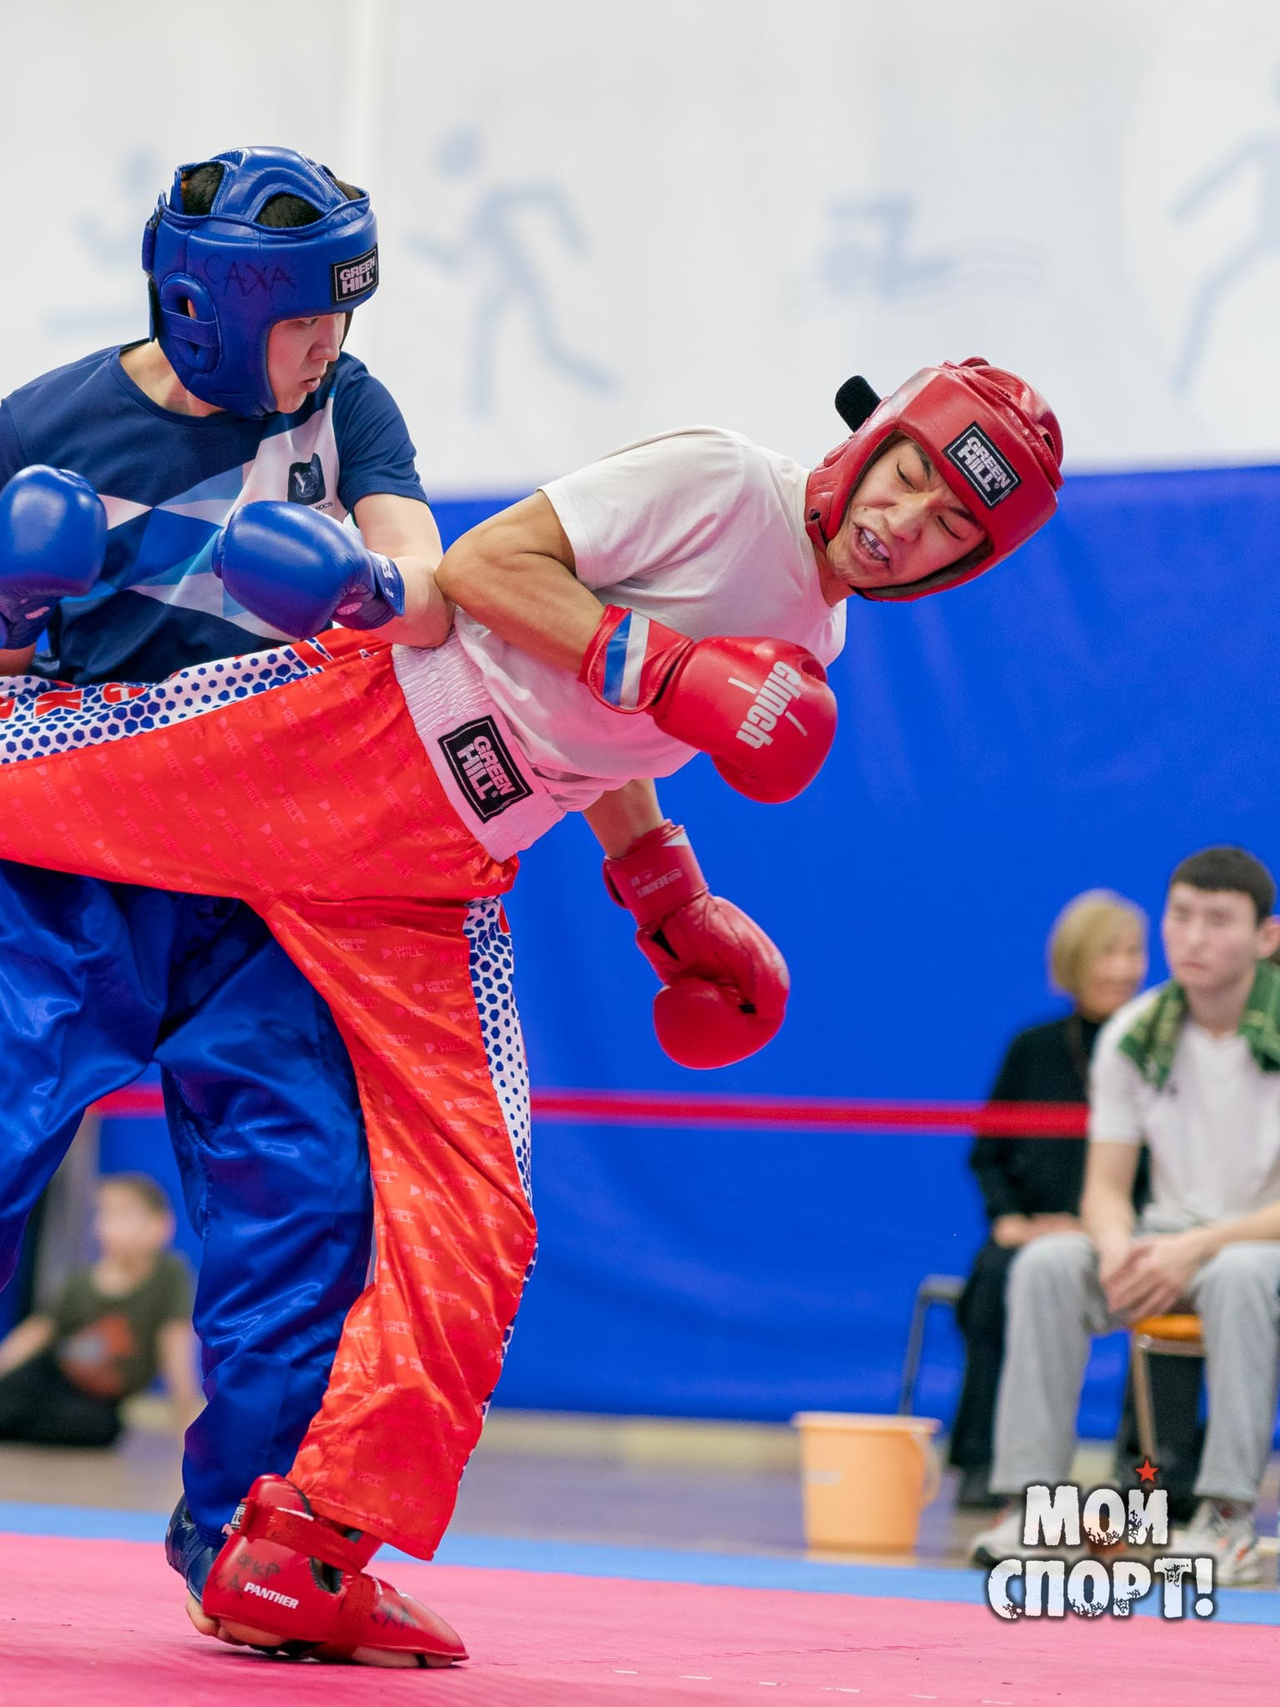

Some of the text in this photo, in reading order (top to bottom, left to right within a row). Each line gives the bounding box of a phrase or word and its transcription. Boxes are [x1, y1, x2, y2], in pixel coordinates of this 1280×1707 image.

[340, 256, 375, 280] GREEN
[342, 271, 373, 294] HILL
[957, 444, 993, 492] HILL
[967, 436, 1011, 488] GREEN
[456, 743, 494, 800] HILL
[473, 735, 516, 796] GREEN
[243, 1581, 299, 1610] PANTHER
